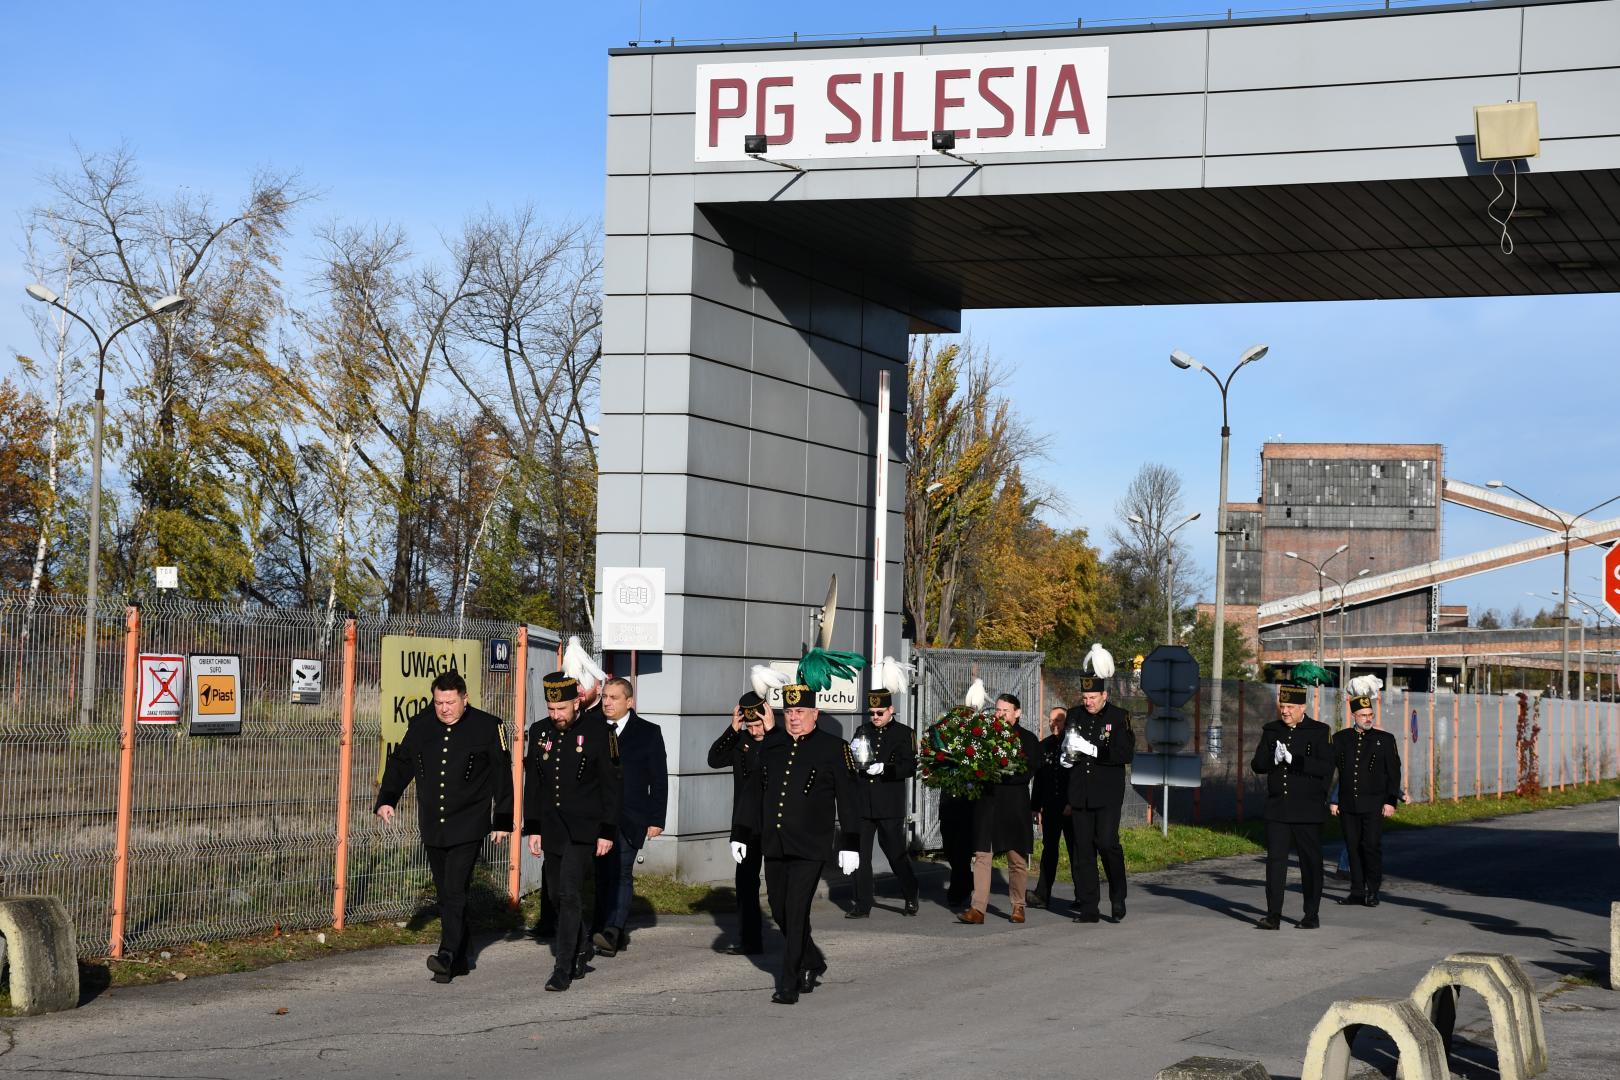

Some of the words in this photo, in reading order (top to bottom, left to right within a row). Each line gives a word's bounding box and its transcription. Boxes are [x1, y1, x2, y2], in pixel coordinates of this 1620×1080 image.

[709, 76, 795, 147] PG
[825, 64, 1090, 144] SILESIA
[496, 643, 507, 661] 60
[401, 650, 459, 678] UWAGA
[212, 688, 234, 701] Piast
[818, 690, 855, 703] ruchu
